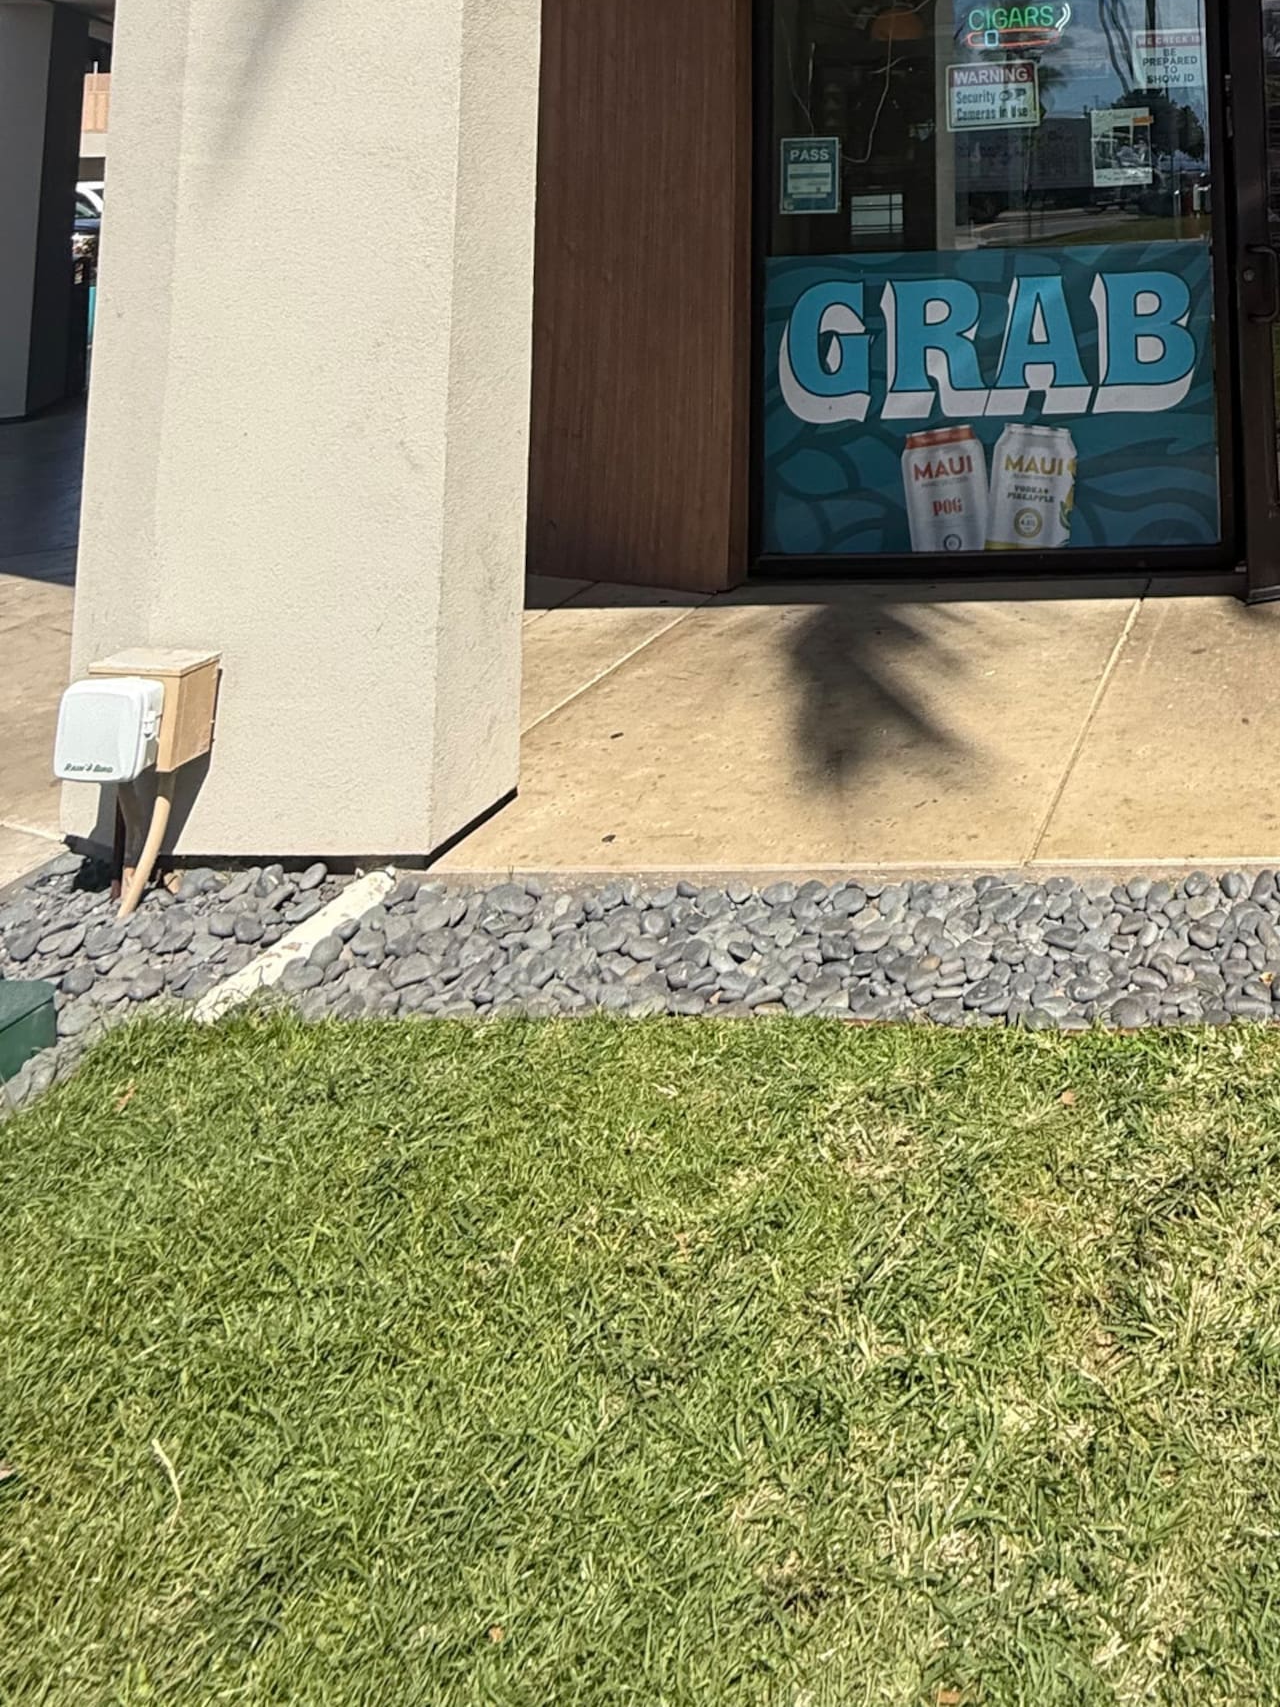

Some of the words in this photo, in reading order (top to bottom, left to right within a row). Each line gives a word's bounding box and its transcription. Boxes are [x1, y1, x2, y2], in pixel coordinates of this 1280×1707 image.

[968, 5, 1054, 31] CIGARS
[1143, 56, 1198, 66] PREPARED
[1163, 48, 1177, 57] BE
[953, 67, 1028, 85] WARNING
[1164, 66, 1178, 74] TO
[1147, 74, 1181, 84] SHOW
[1184, 74, 1195, 83] ID
[956, 88, 996, 105] Security
[957, 107, 996, 121] Cameras
[1011, 105, 1028, 119] Use
[790, 148, 829, 161] PASS
[778, 270, 1198, 424] GRAB
[913, 455, 973, 481] MAUI
[1004, 454, 1064, 476] MAUI
[932, 498, 963, 516] POG
